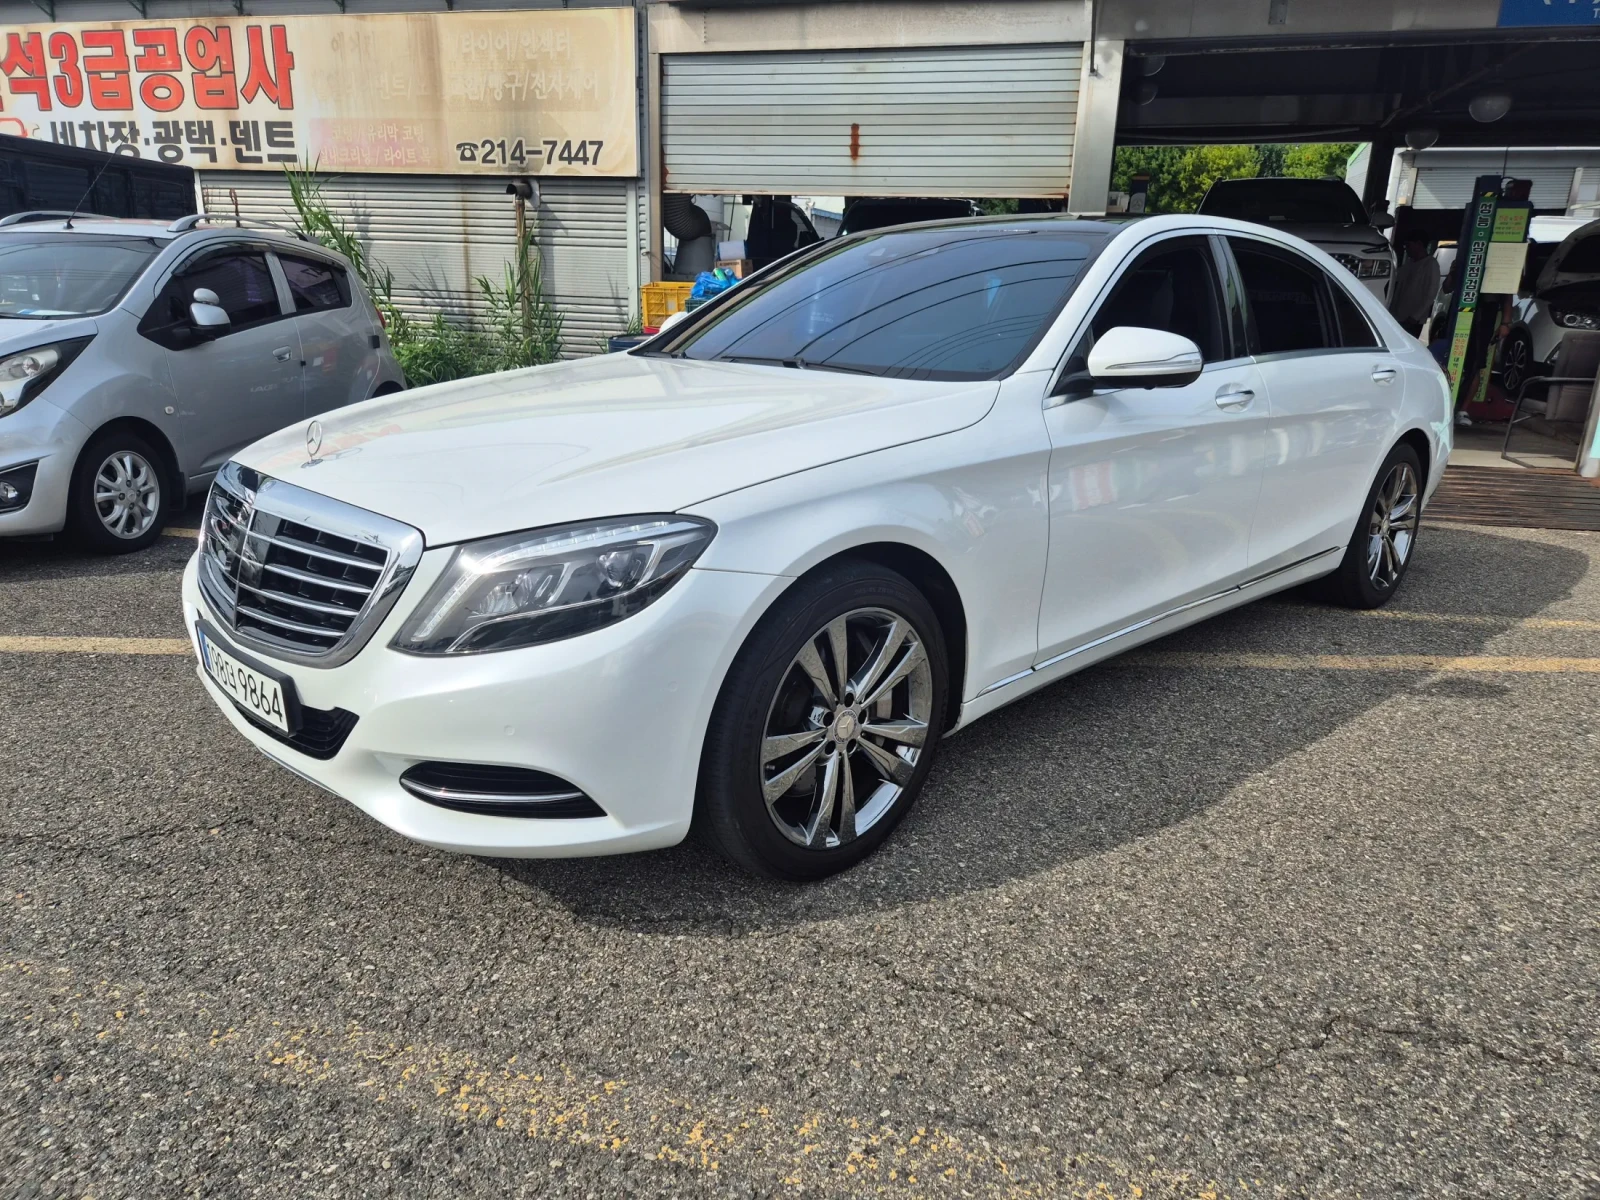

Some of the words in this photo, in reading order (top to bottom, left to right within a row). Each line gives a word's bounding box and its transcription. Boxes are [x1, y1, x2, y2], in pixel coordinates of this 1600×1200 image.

[0, 25, 295, 112] 석3급공업사
[367, 122, 399, 143] 유리막
[403, 123, 424, 143] 코팅
[383, 146, 418, 166] 라이트
[481, 139, 604, 166] 214-7447
[237, 667, 283, 723] 9864
